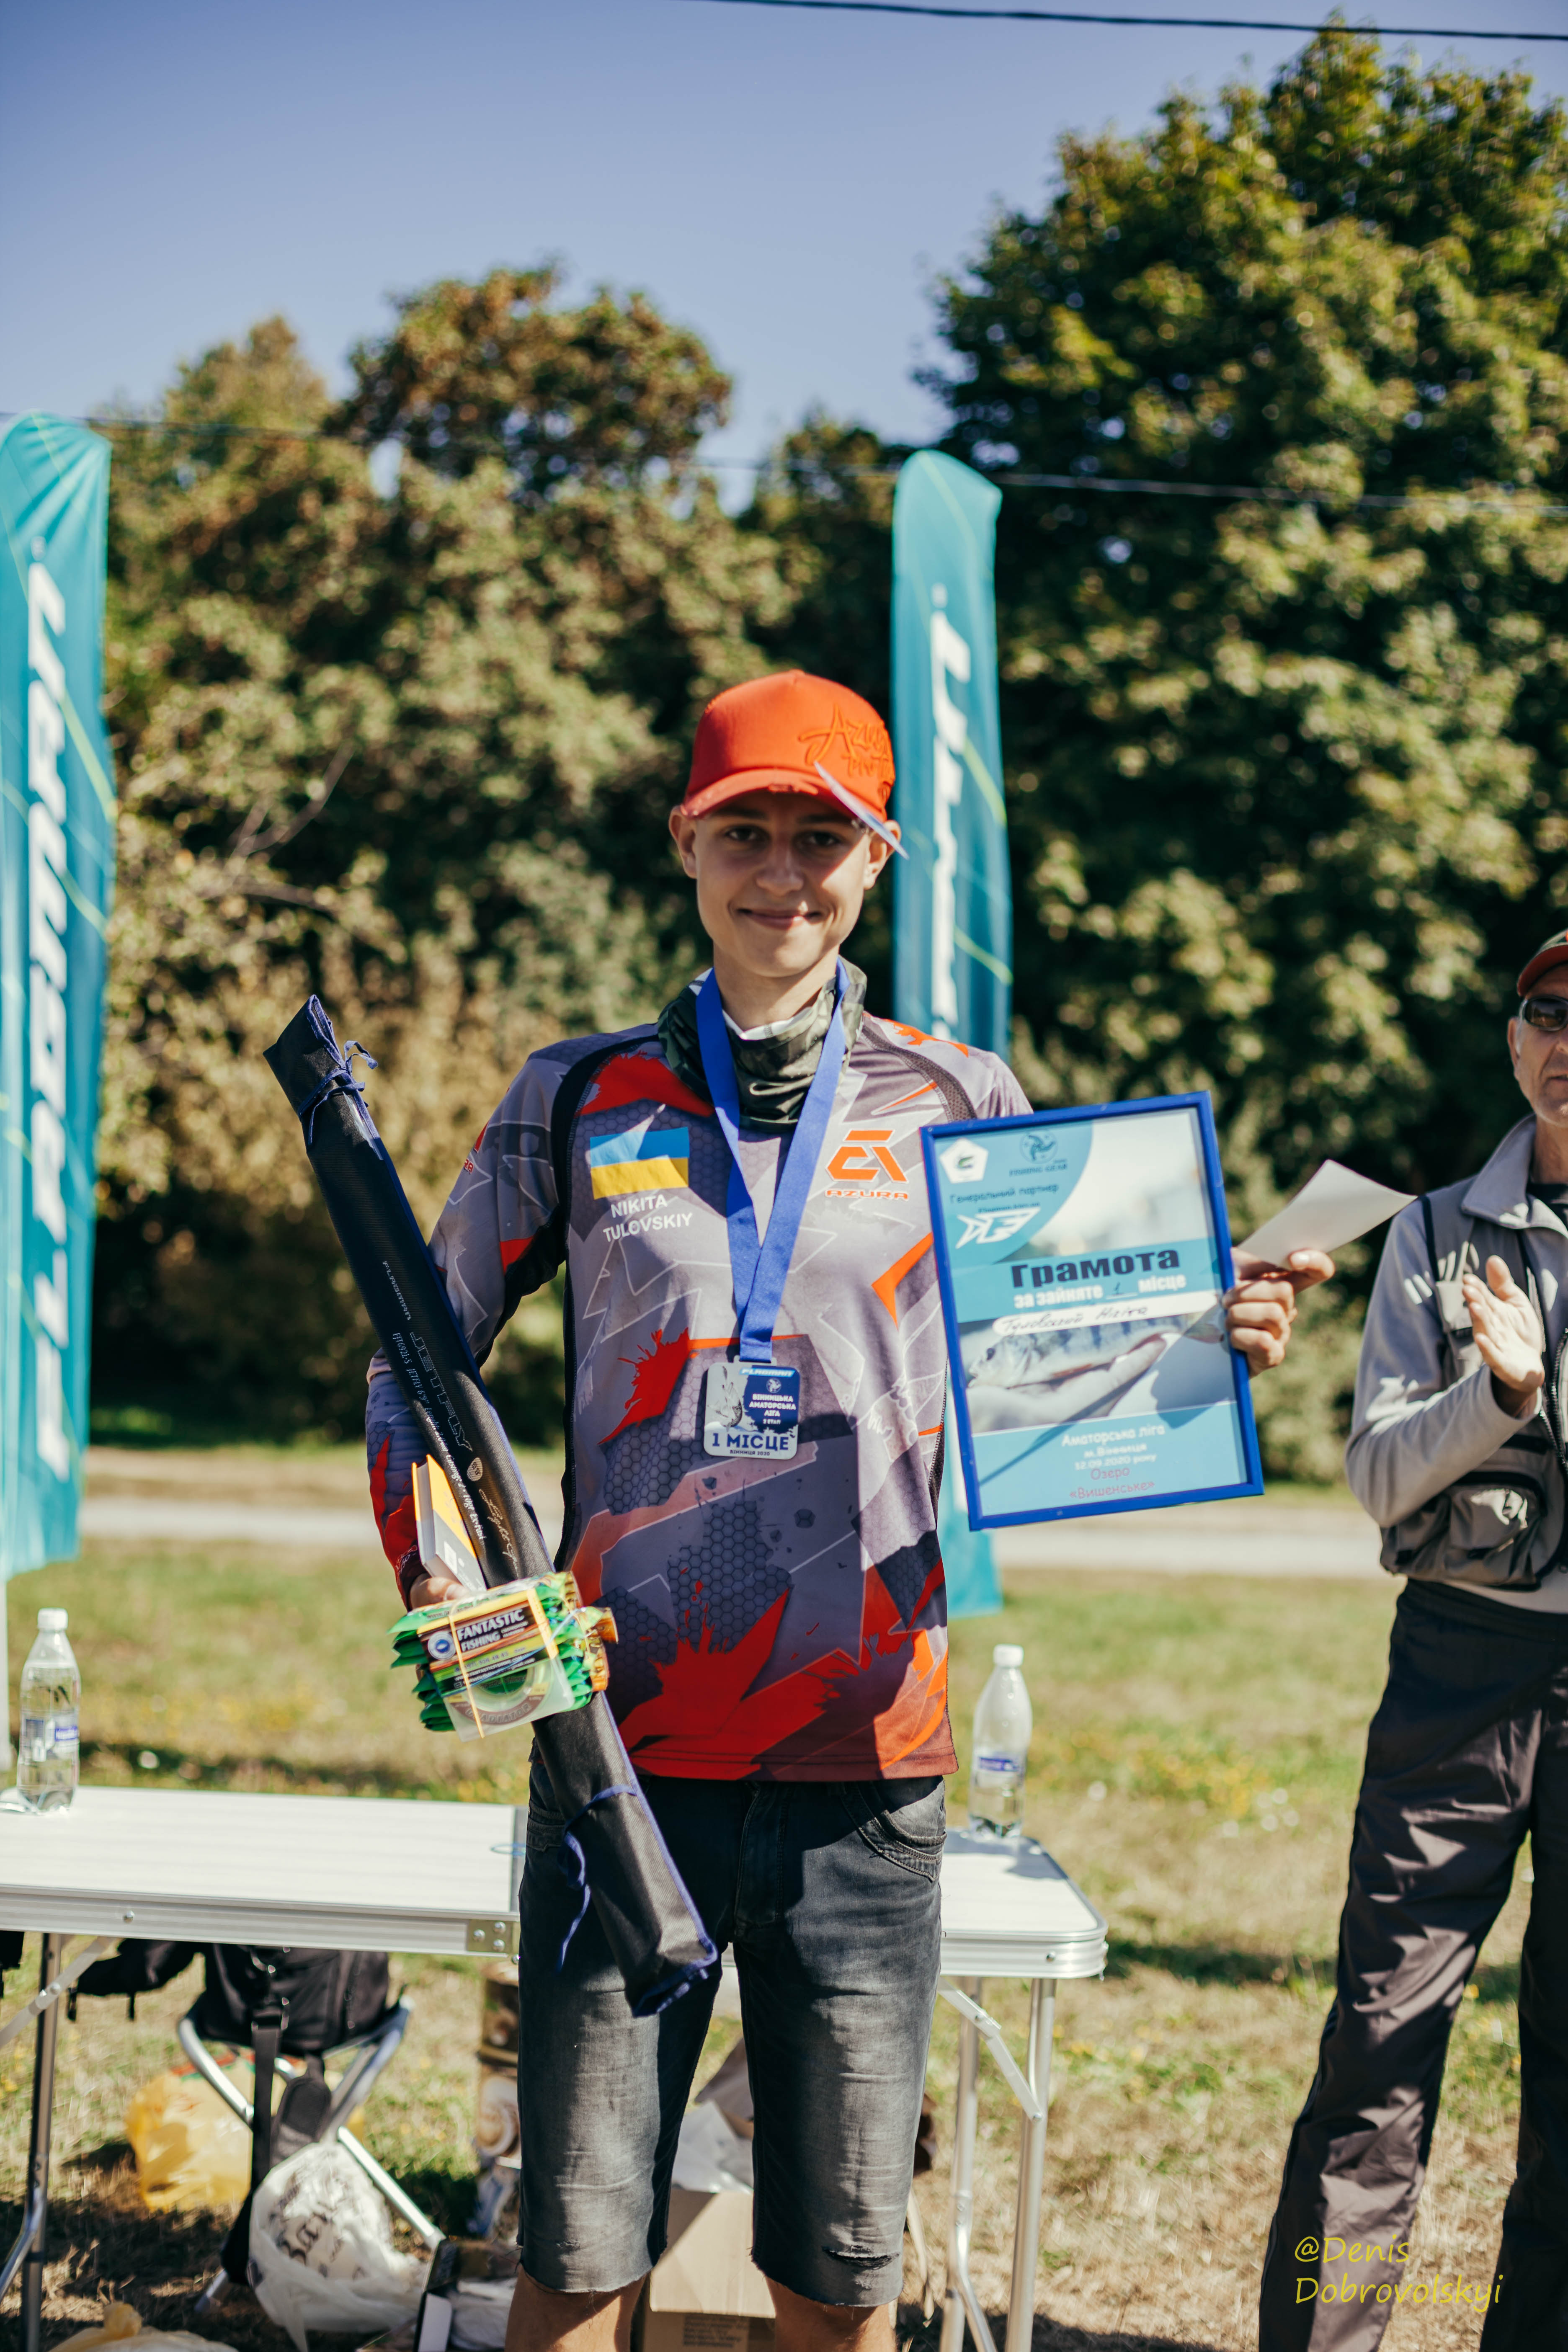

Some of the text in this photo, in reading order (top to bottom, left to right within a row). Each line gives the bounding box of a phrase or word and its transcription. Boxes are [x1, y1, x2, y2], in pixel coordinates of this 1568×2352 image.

[28, 560, 70, 1480] FLAGMAN
[611, 1194, 668, 1218] NIKITA
[826, 1189, 908, 1200] AZURA
[603, 1212, 693, 1242] TULOVSKIY
[1011, 1249, 1180, 1288] Грамота
[382, 1260, 413, 1320] FLAGMAN
[1014, 1294, 1034, 1309] за
[1036, 1284, 1103, 1307] зайняте
[1138, 1274, 1187, 1293] місце
[408, 1329, 473, 1455] JETFLY
[752, 1393, 794, 1402] ВІННИЦЬКА
[749, 1401, 796, 1410] АМАТОРСЬКА
[712, 1433, 789, 1451] 1 МІСЦЕ
[1062, 1424, 1166, 1447] Аматорська ліга
[1091, 1467, 1130, 1480] Озеро
[1069, 1481, 1155, 1499] «Вишенське»
[456, 1609, 525, 1641] FANTASTIC
[461, 1631, 501, 1652] FISHING
